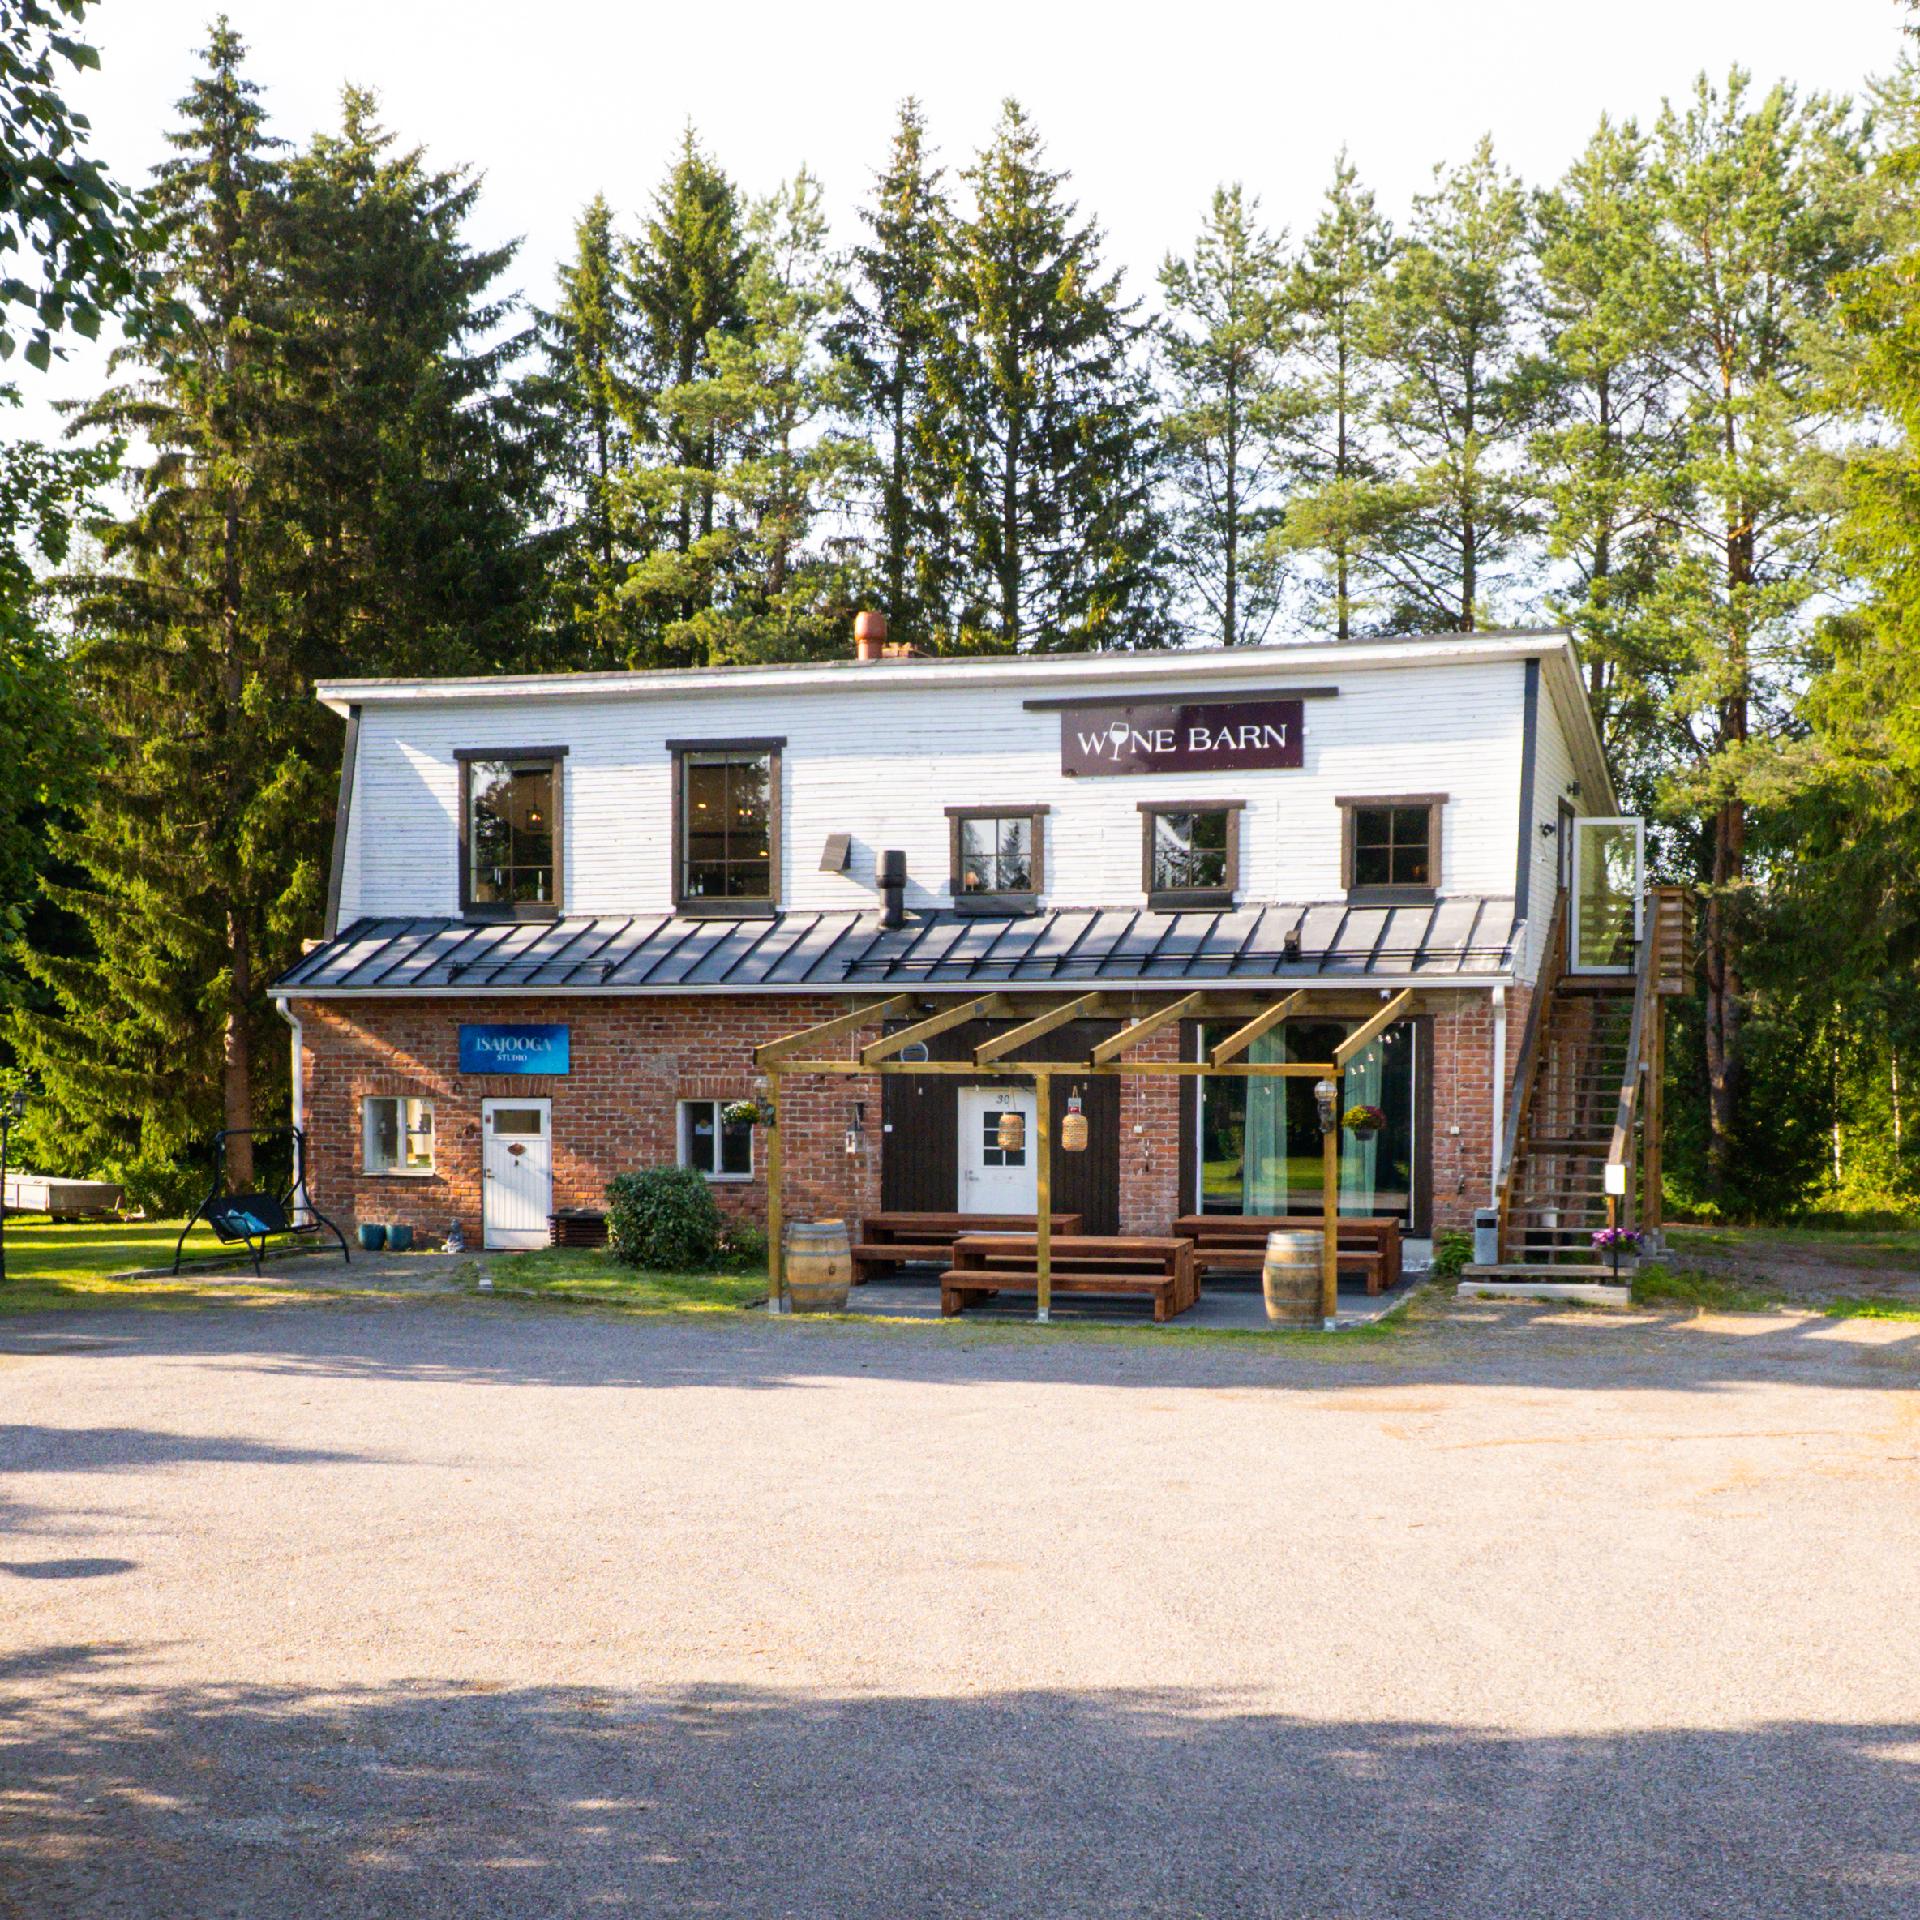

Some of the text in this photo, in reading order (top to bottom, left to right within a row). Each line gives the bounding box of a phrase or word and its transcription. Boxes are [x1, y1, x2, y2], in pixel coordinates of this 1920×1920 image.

[1188, 723, 1288, 751] BARN
[476, 1036, 552, 1053] ISAJOOGA
[496, 1053, 527, 1062] STUDIO
